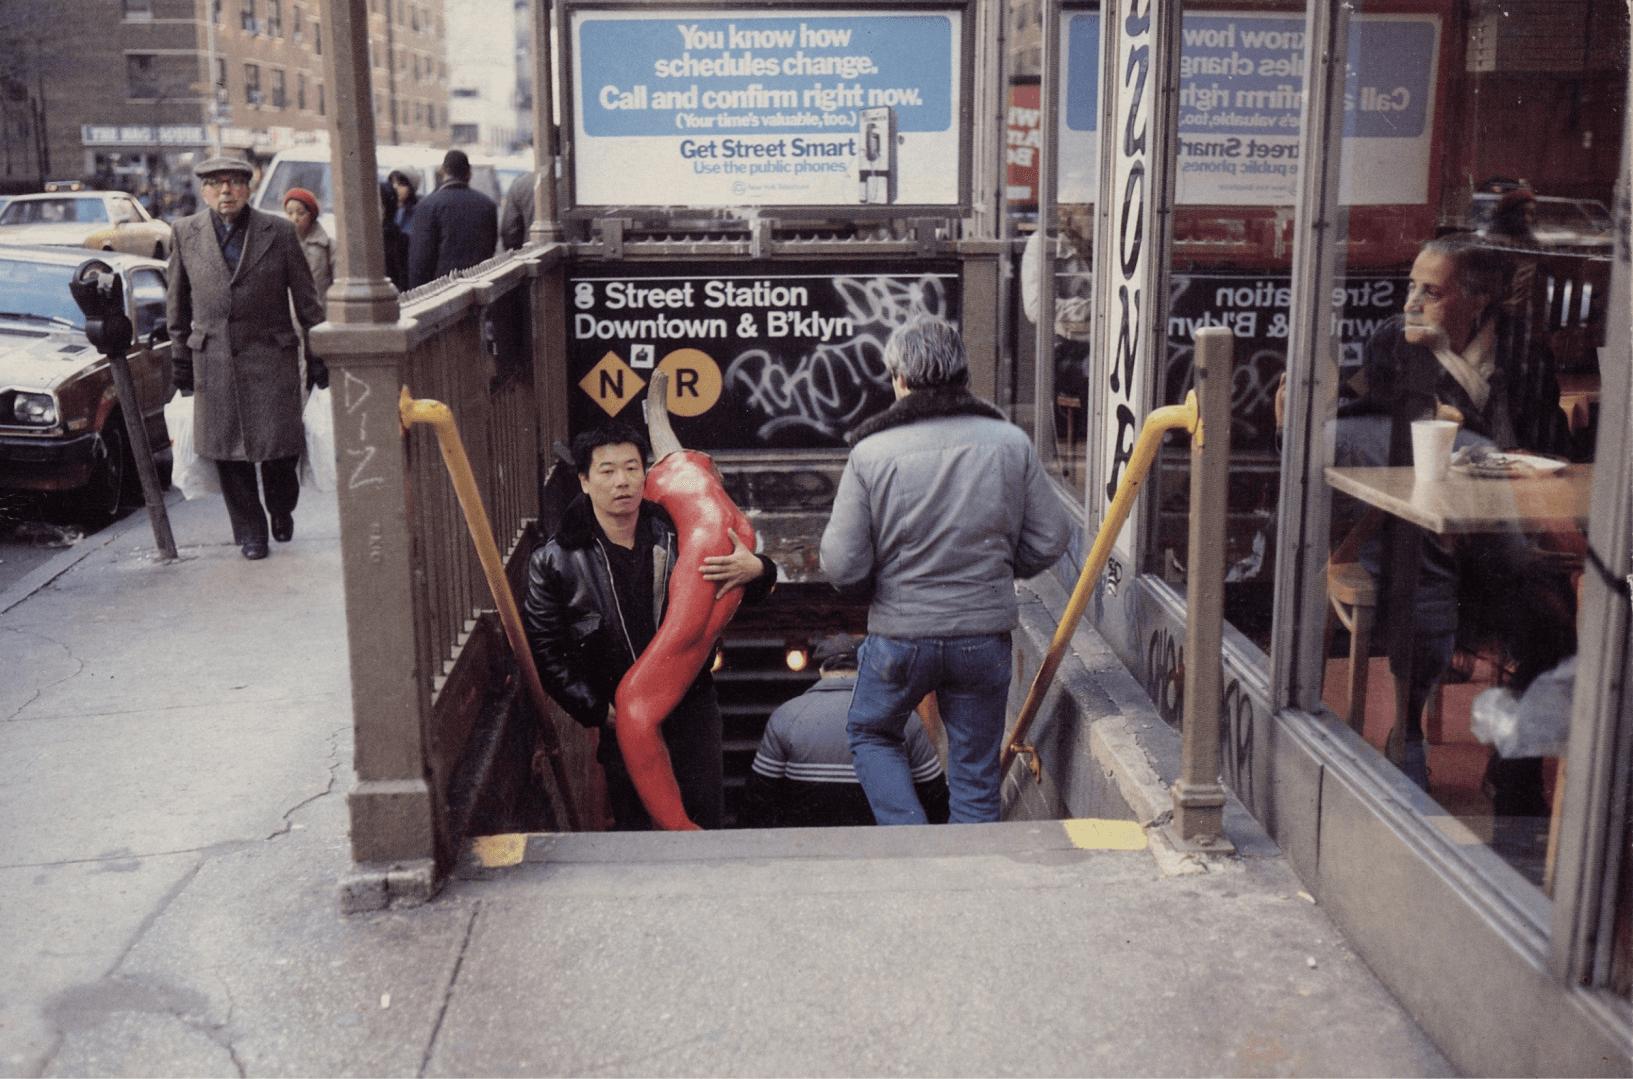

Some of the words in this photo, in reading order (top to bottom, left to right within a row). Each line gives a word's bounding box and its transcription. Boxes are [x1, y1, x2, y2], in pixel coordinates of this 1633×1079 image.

[678, 24, 723, 50] You
[729, 23, 795, 49] know
[800, 22, 852, 48] how
[654, 52, 780, 78] schedules
[782, 51, 879, 78] change.
[599, 85, 648, 110] Call
[651, 85, 699, 109] and
[701, 83, 799, 109] confirm
[802, 83, 864, 111] right
[867, 88, 923, 107] now.
[675, 111, 715, 129] (Your
[717, 111, 759, 129] time's
[761, 110, 822, 127] valuable,
[823, 110, 857, 127] too.)
[680, 139, 717, 159] Get
[722, 138, 786, 158] Street
[791, 137, 856, 157] Smart
[693, 161, 720, 175] Use
[723, 160, 747, 174] the
[750, 158, 791, 177] public
[794, 158, 848, 176] phones
[574, 282, 595, 310] 8
[605, 282, 695, 310] Street
[704, 280, 808, 307] Station
[575, 313, 727, 340] Downtown
[736, 314, 758, 338] &
[768, 311, 854, 341] B'klyn
[600, 369, 624, 399] N
[676, 368, 699, 398] R
